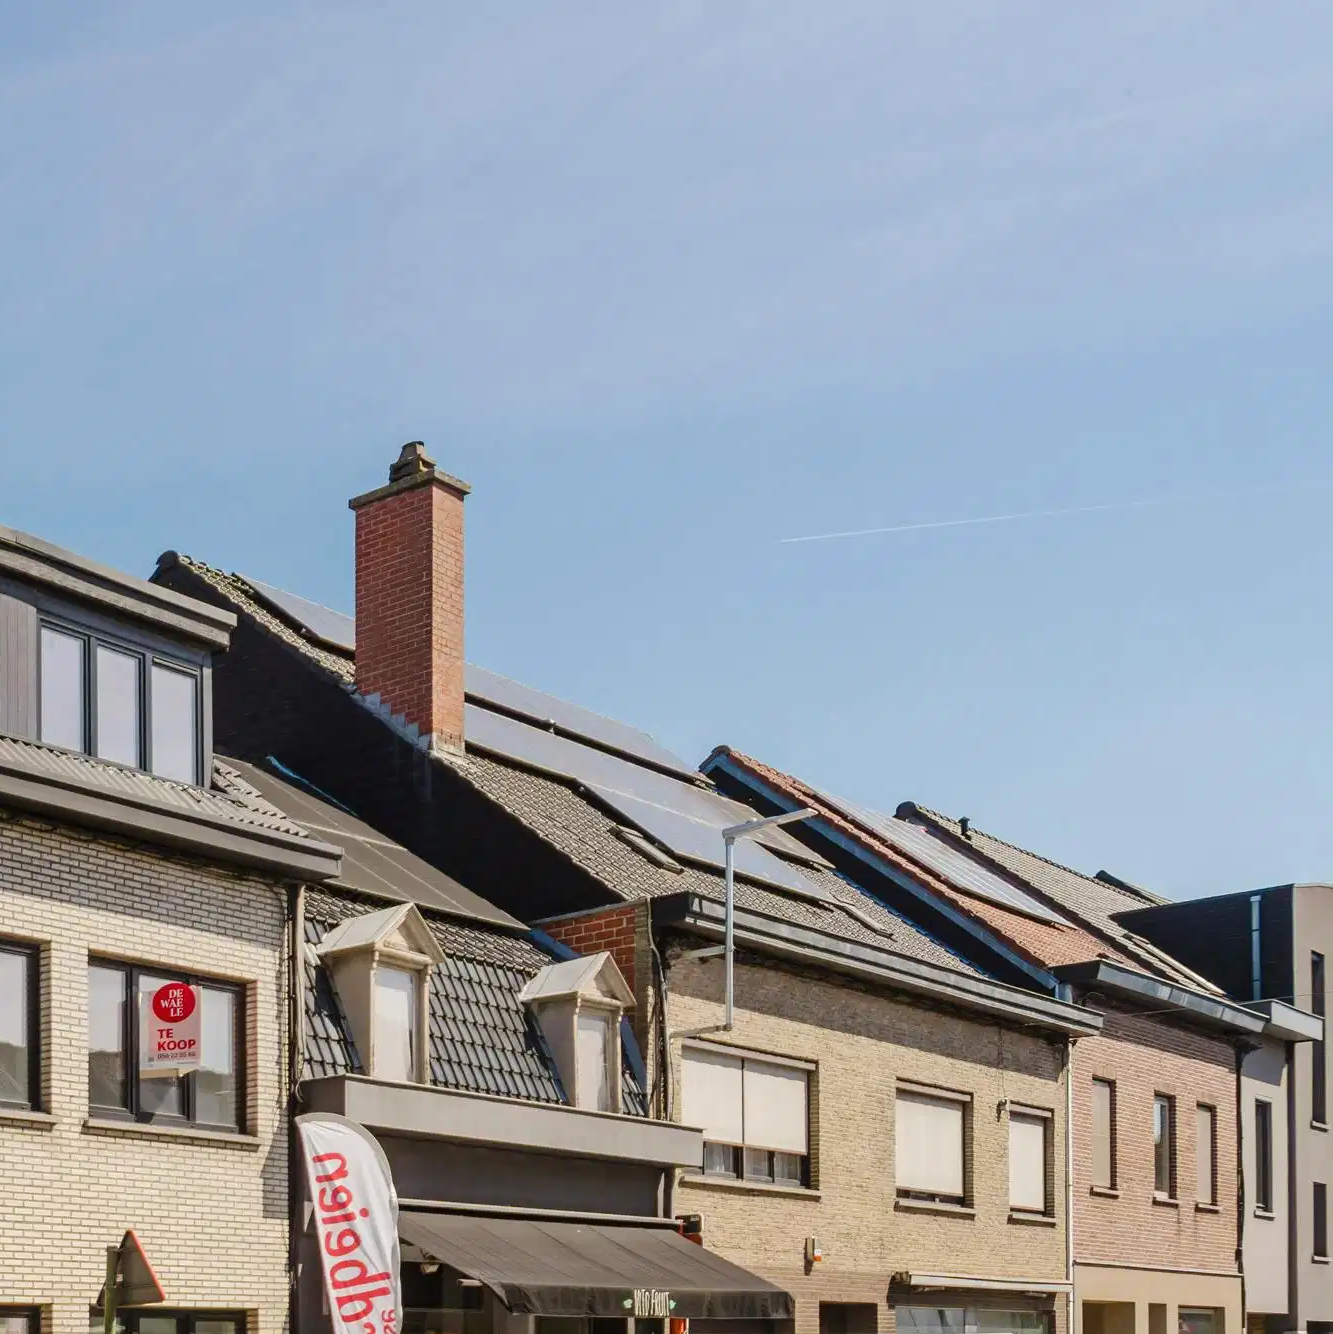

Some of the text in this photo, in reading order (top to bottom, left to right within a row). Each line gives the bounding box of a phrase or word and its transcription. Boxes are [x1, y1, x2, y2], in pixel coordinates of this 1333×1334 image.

[168, 988, 184, 998] DE
[160, 998, 184, 1009] WAE
[170, 1007, 184, 1017] LE
[157, 1028, 174, 1039] TE
[157, 1038, 196, 1052] KOOP
